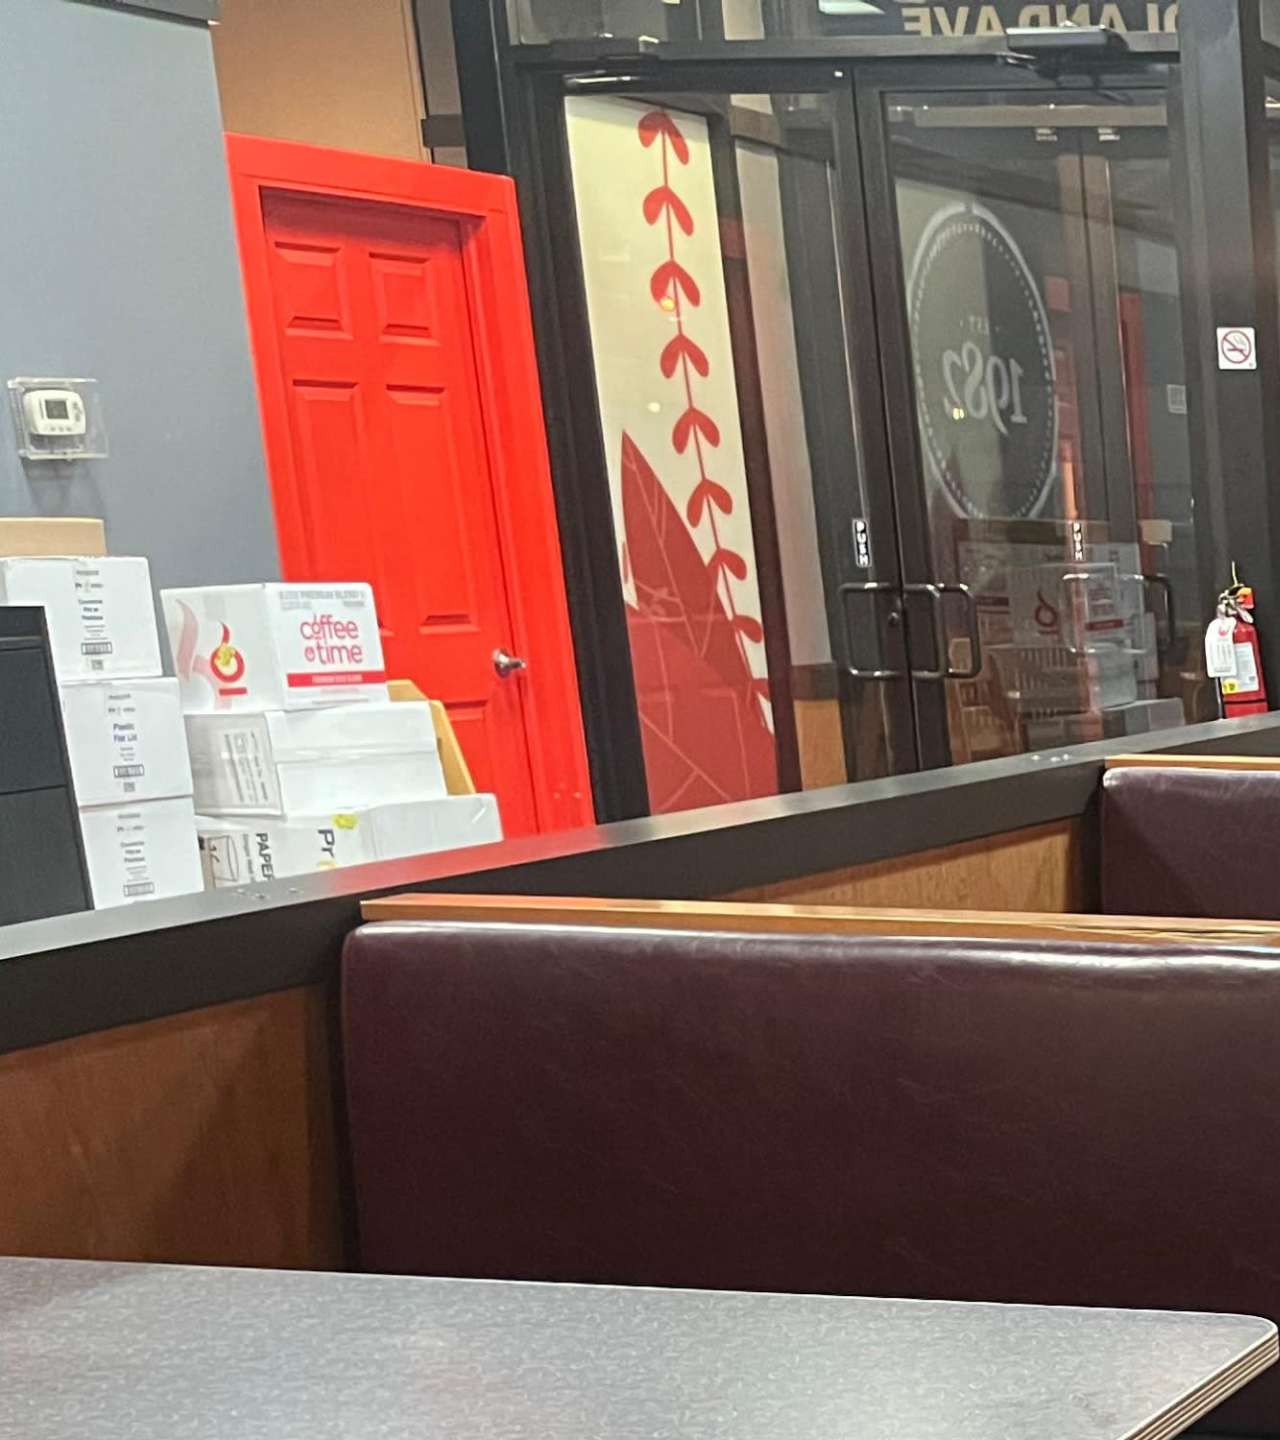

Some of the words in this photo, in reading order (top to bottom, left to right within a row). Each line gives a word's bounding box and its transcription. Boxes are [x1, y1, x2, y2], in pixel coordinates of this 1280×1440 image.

[855, 520, 869, 566] PUSH
[1072, 522, 1084, 561] PUSH
[300, 613, 359, 640] coffee
[316, 639, 363, 665] time
